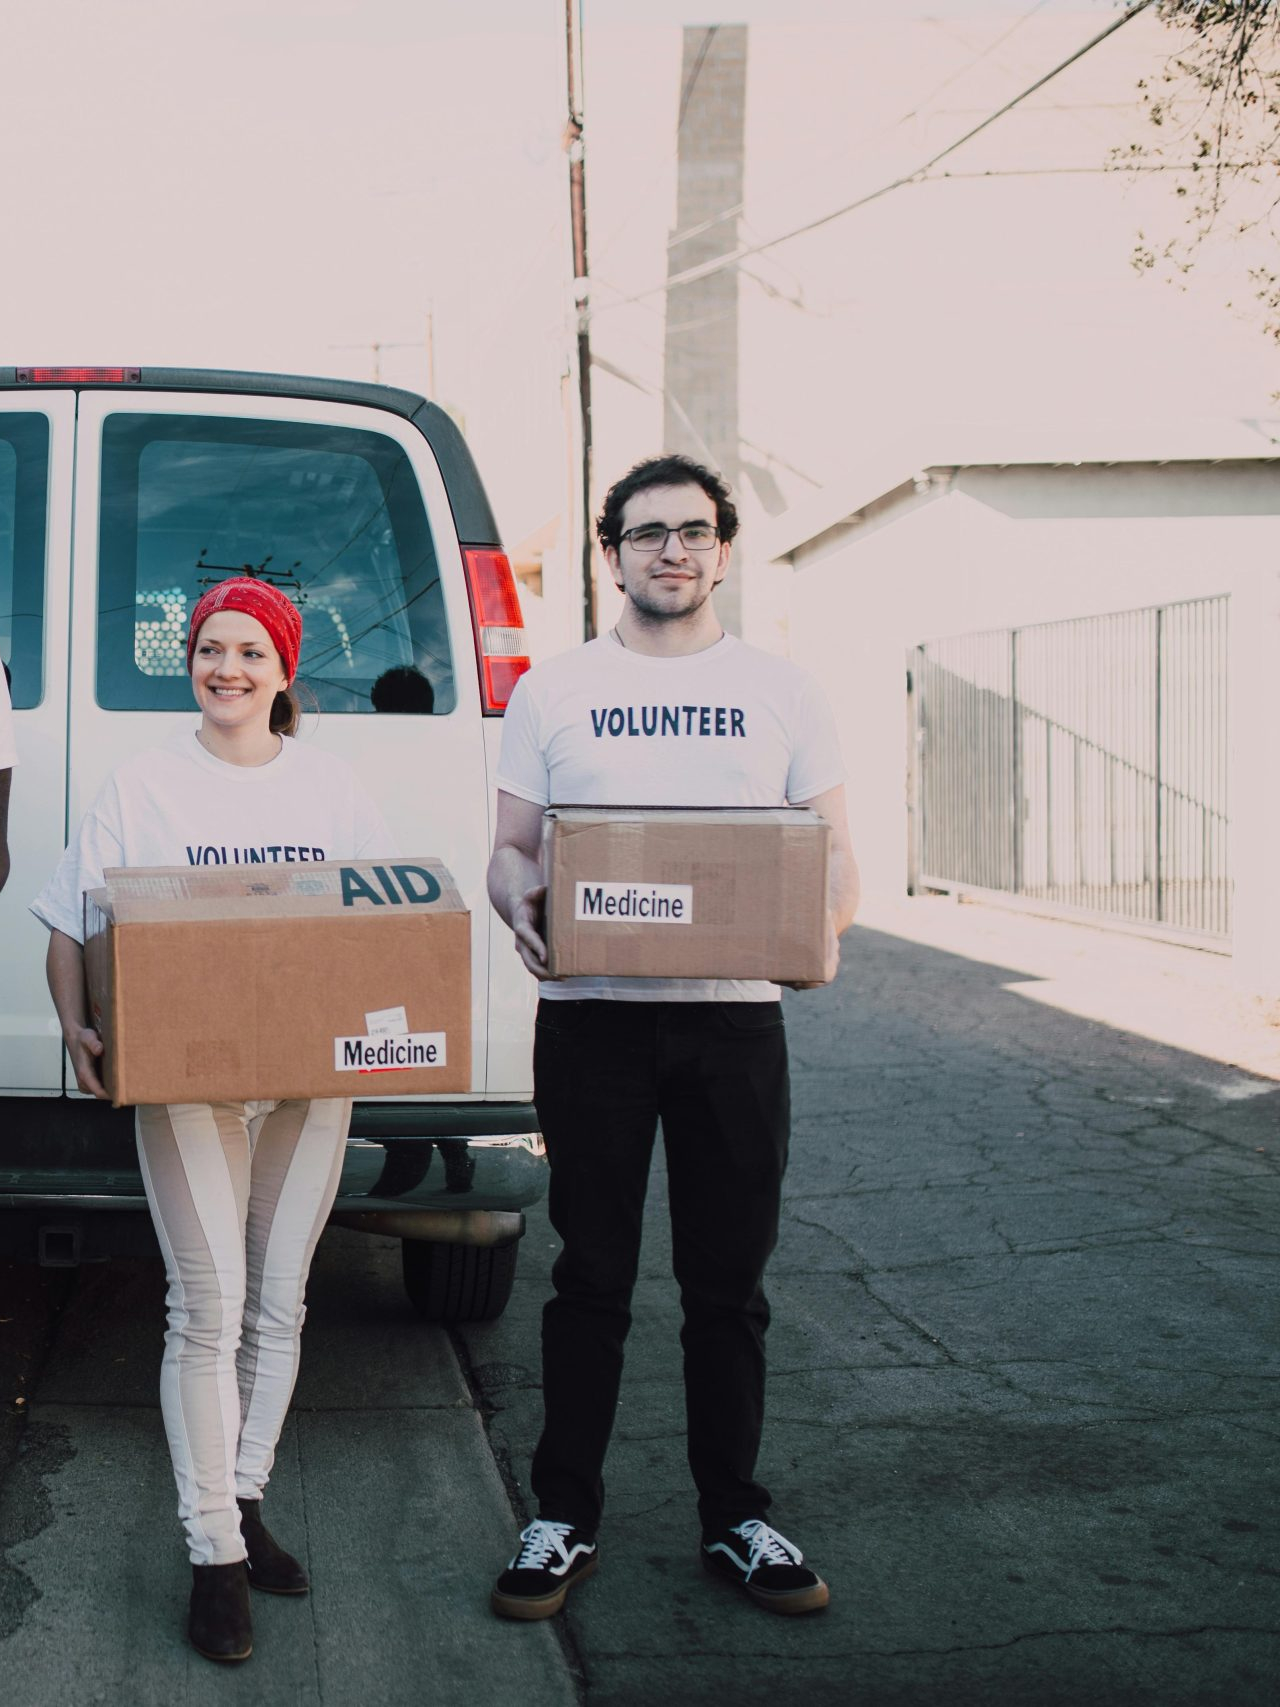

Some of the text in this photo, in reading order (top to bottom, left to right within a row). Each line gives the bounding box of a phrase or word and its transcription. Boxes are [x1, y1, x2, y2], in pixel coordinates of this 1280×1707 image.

[590, 705, 746, 738] VOLUNTEER
[339, 864, 442, 907] AID
[583, 887, 683, 918] Medicine
[344, 1038, 437, 1066] Medicine
